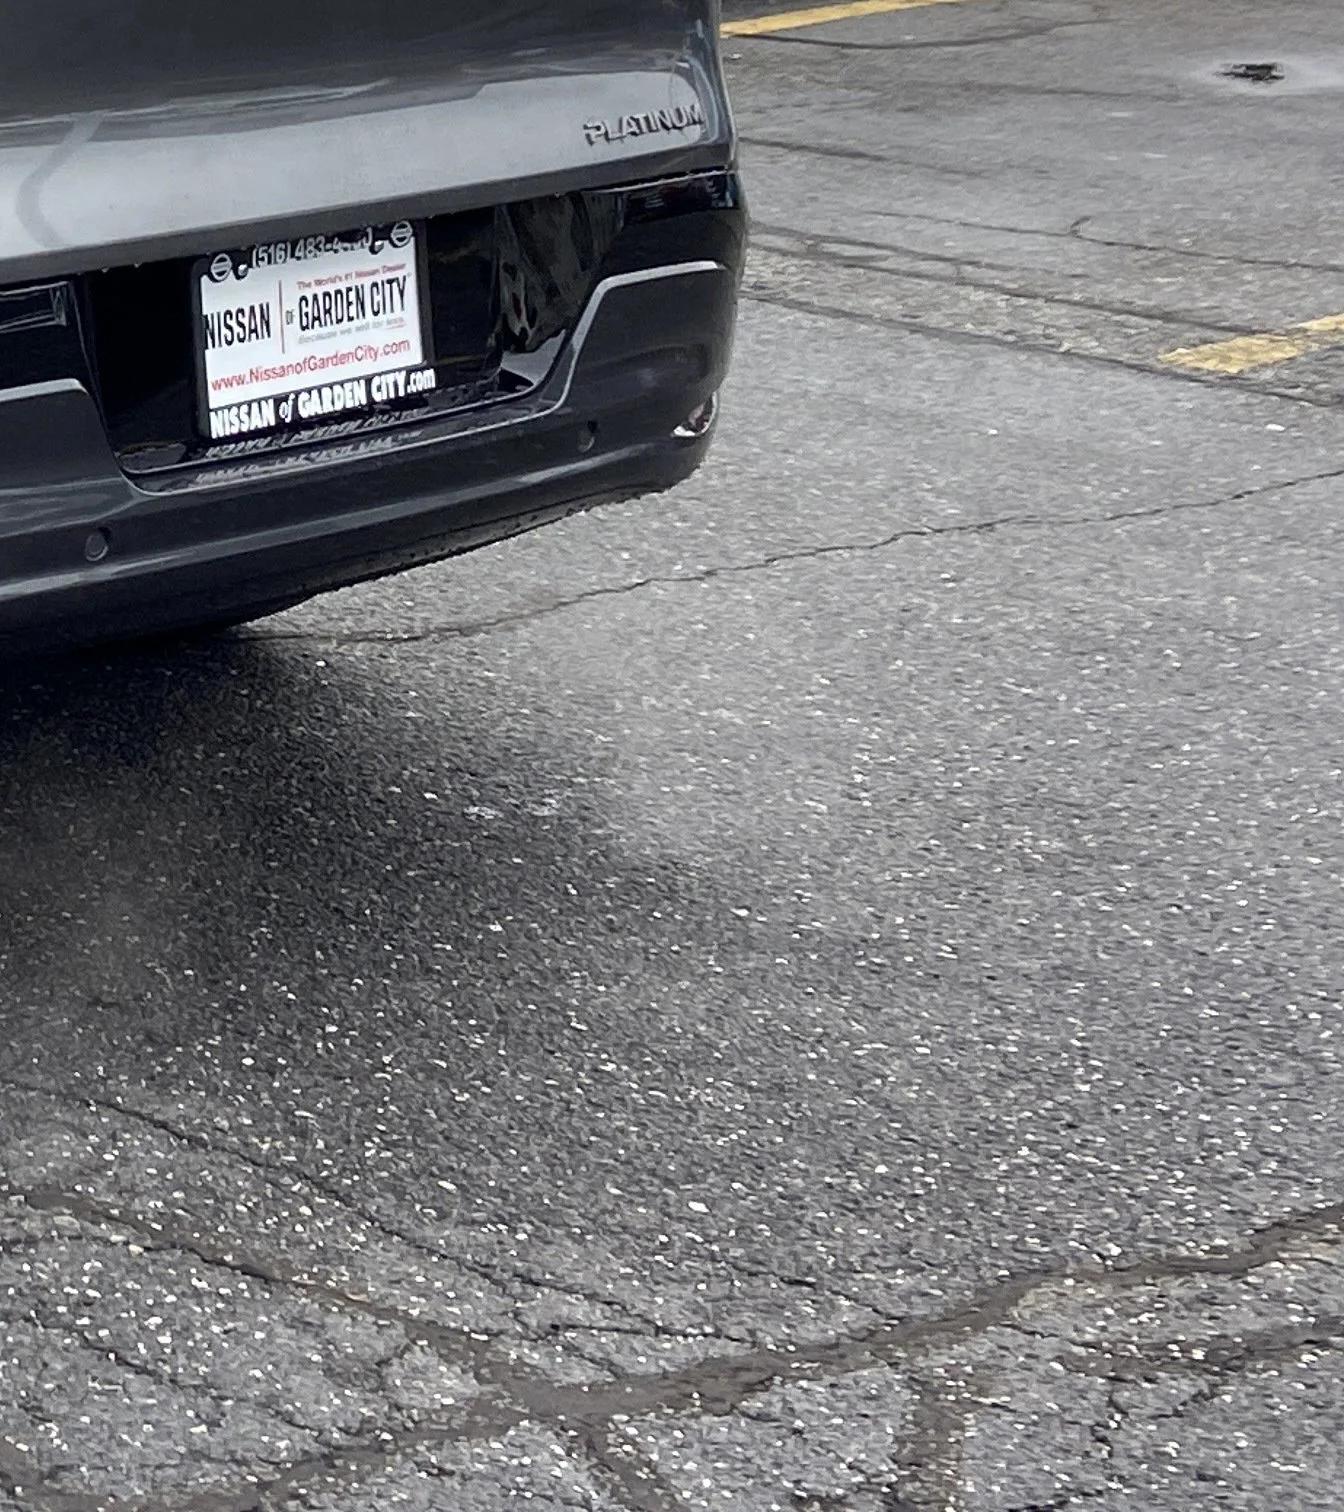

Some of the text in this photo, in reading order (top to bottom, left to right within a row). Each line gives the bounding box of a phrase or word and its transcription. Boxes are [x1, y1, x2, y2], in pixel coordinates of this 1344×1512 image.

[582, 103, 707, 146] PLATINUM
[204, 302, 271, 350] NISSAN
[298, 283, 366, 331] GARDEN
[370, 275, 406, 316] CITY
[211, 337, 411, 392] www.NissanofGardenCity.com
[210, 368, 435, 439] NISSAN of GARDEN CITY.com
